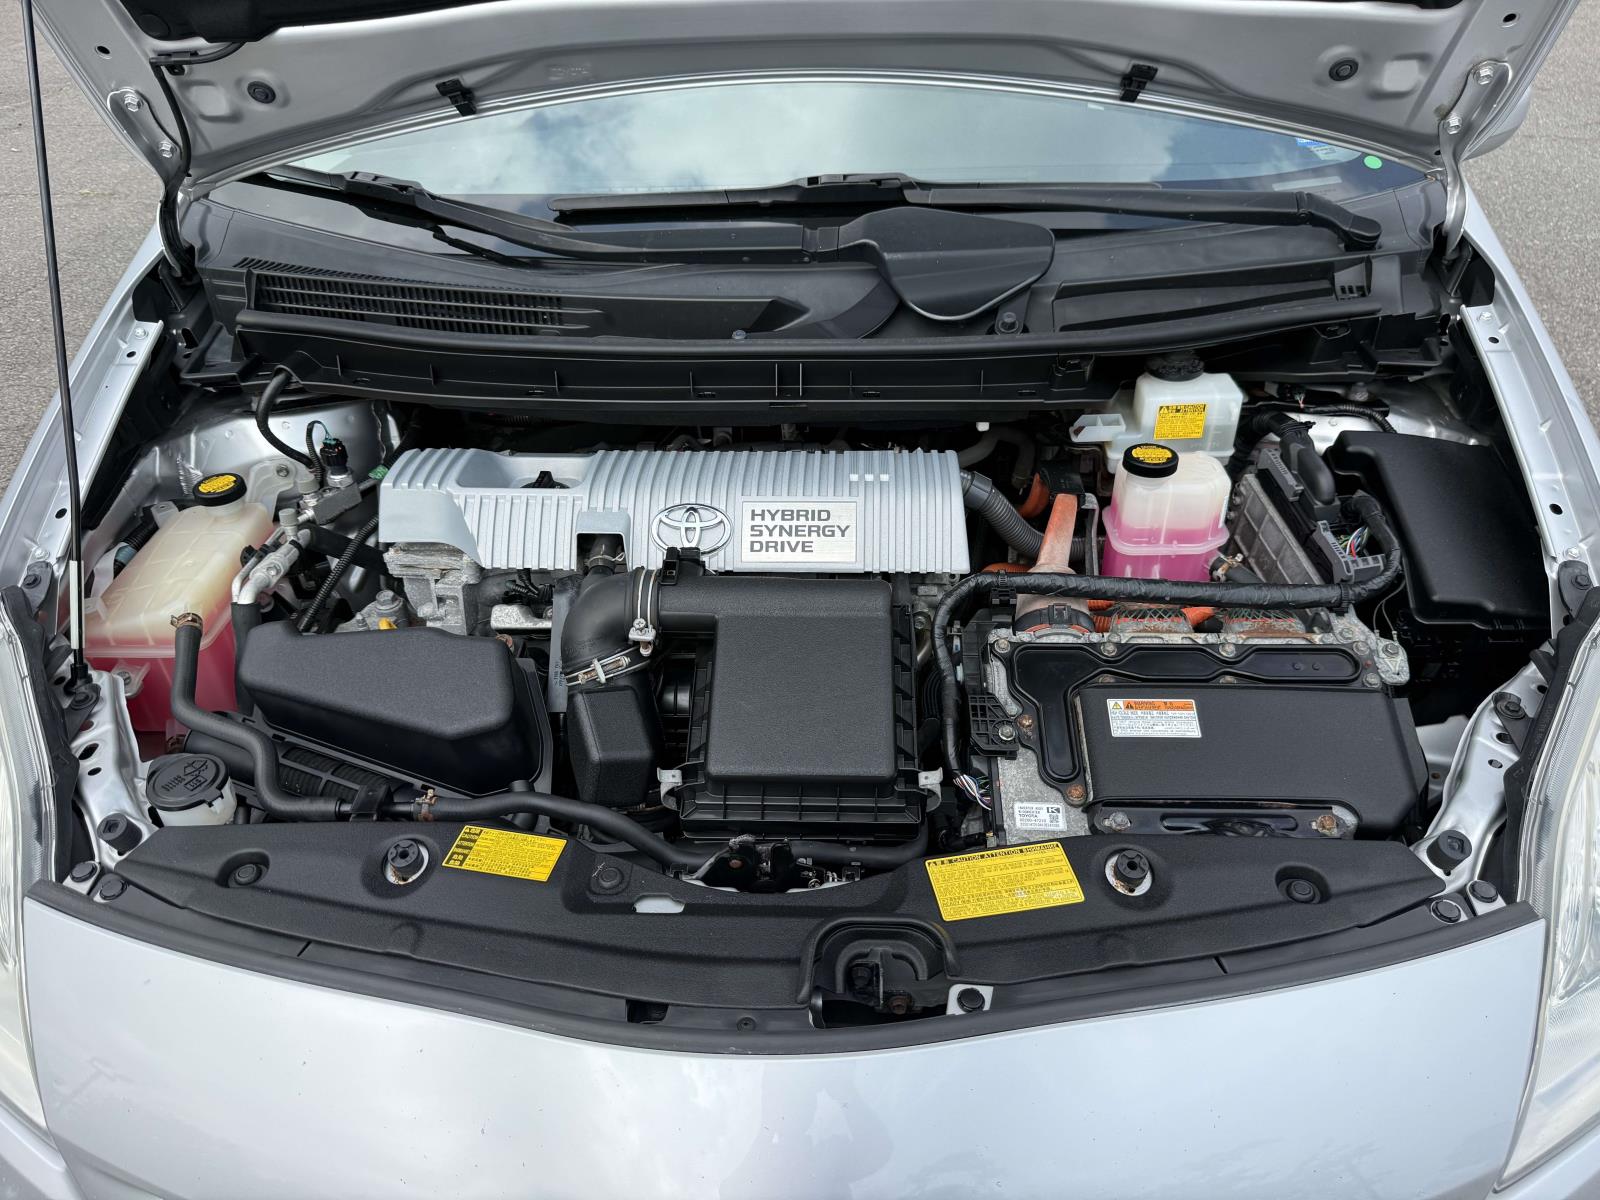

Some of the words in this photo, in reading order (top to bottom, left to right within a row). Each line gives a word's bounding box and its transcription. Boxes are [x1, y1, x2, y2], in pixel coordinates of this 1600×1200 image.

[750, 509, 831, 521] HYBRID
[750, 524, 850, 537] SYNERGY
[750, 540, 814, 552] DRIVE
[952, 855, 981, 864] CAUTION
[984, 849, 1021, 859] ATTENTION
